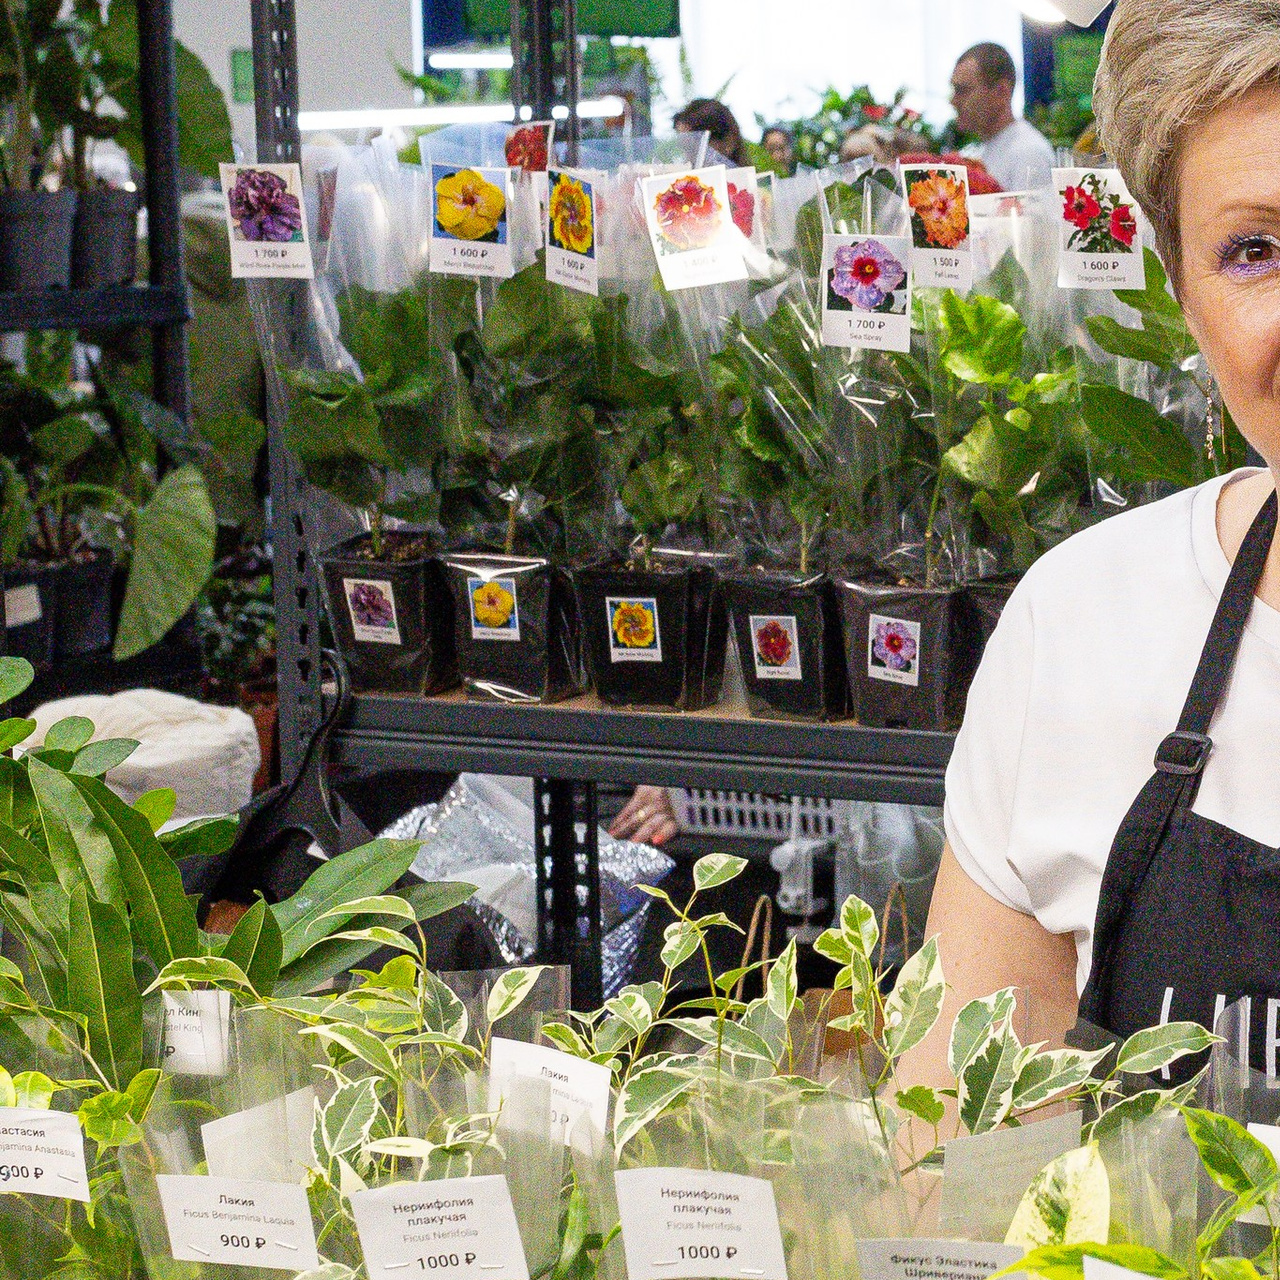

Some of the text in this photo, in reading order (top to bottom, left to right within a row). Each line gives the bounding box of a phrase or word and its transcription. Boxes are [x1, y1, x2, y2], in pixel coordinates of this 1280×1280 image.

[460, 248, 479, 258] 600
[1090, 261, 1109, 271] 600
[856, 319, 876, 330] 700
[540, 1065, 570, 1084] Лакия
[0, 1125, 46, 1139] астасия
[218, 1193, 255, 1208] Лакия
[660, 1186, 740, 1203] Нериифолия
[392, 1195, 475, 1215] Нериифолия
[672, 1202, 733, 1216] плакучая
[183, 1208, 209, 1220] Ficus
[211, 1211, 262, 1226] Benjamina
[406, 1210, 467, 1228] плакучая
[219, 1233, 250, 1249] 900
[676, 1245, 721, 1261] 1000
[415, 1253, 461, 1272] 1000
[889, 1253, 998, 1271] Фикус Эластика
